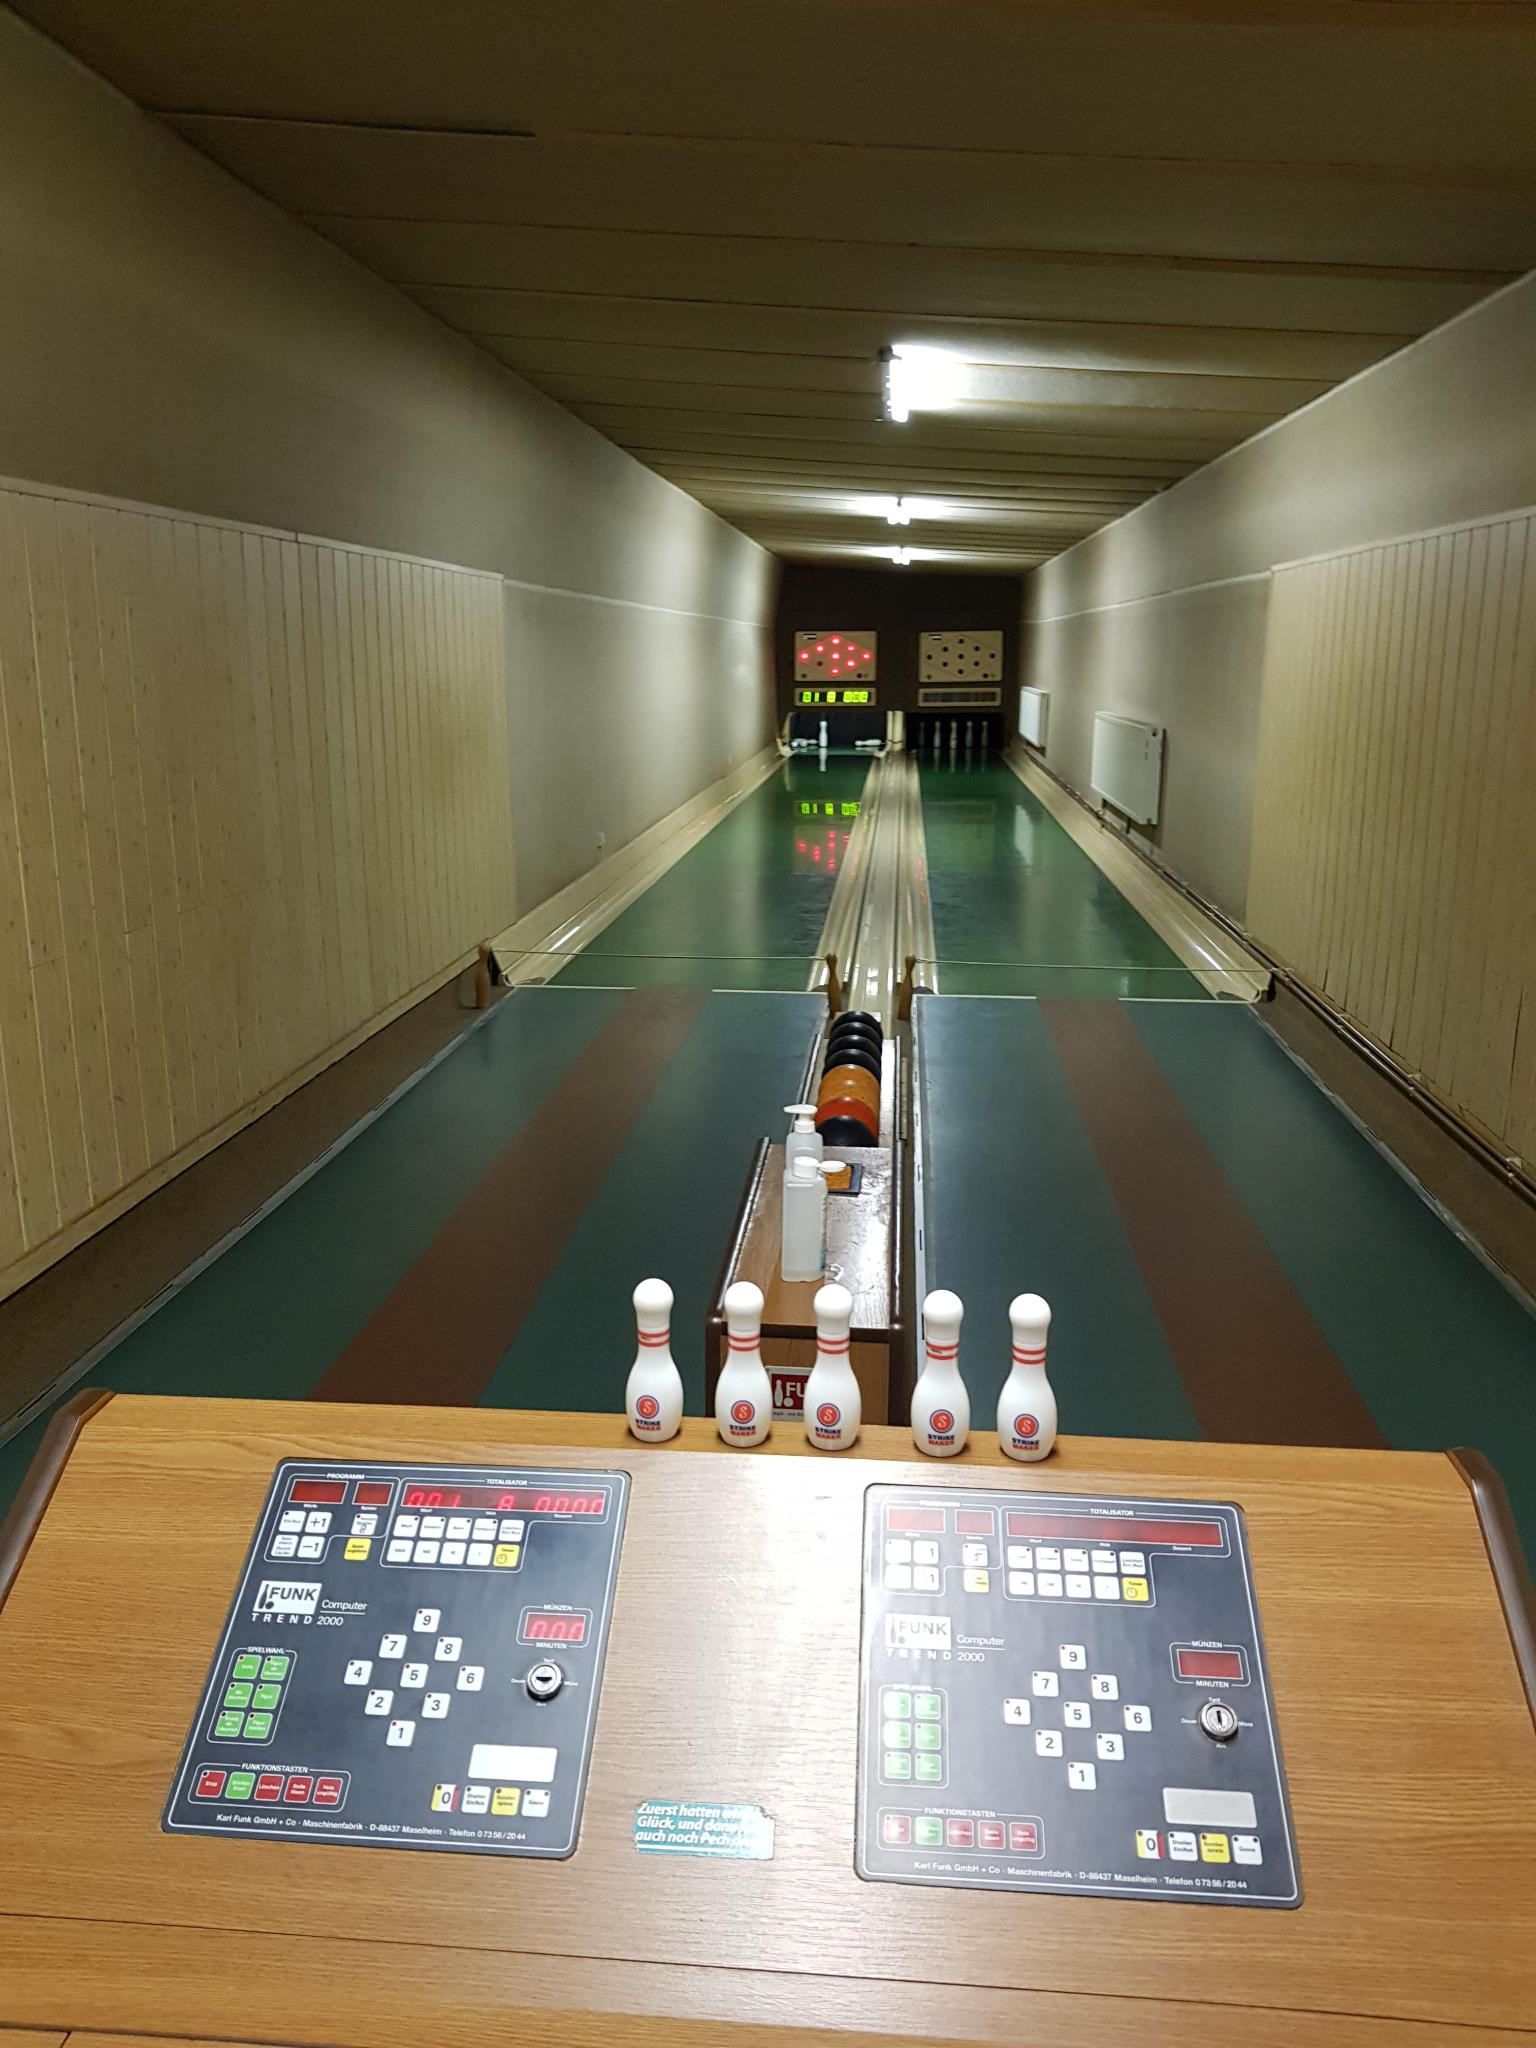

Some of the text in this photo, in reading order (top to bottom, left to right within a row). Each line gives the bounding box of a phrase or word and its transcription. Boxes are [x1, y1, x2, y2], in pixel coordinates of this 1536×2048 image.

[786, 1382, 805, 1398] FU
[1090, 1508, 1134, 1516] TOTALISATOR
[311, 1518, 326, 1526] +1
[269, 1587, 317, 1601] FUNK
[322, 1600, 367, 1610] Computer
[252, 1613, 312, 1625] TREND
[317, 1616, 343, 1626] 2000
[423, 1615, 431, 1625] 9
[899, 1621, 947, 1635] FUNK
[957, 1634, 1004, 1646] Computer
[1192, 1640, 1223, 1648] MÜNZEN
[246, 1646, 285, 1654] SPIELWAHL
[389, 1641, 398, 1651] 7
[444, 1644, 453, 1654] 8
[886, 1648, 951, 1660] TREND
[957, 1652, 984, 1662] 2000
[1069, 1651, 1077, 1662] 9
[354, 1667, 362, 1678] 4
[410, 1670, 419, 1680] 5
[466, 1673, 475, 1683] 6
[1041, 1678, 1049, 1689] 7
[1101, 1682, 1109, 1692] 8
[1195, 1680, 1229, 1688] MINUTEN
[374, 1697, 384, 1708] 2
[432, 1700, 440, 1711] 3
[1014, 1706, 1022, 1716] 4
[1073, 1709, 1082, 1720] 5
[1134, 1712, 1142, 1724] 6
[1045, 1738, 1054, 1749] 2
[1106, 1741, 1115, 1752] 3
[242, 1763, 309, 1773] FUNKTIONSTASTEN
[442, 1792, 451, 1804] 0
[637, 1802, 678, 1815] Zuerst
[679, 1805, 720, 1818] hatten
[924, 1807, 995, 1818] FUNKTIONSTASTEN
[216, 1814, 232, 1822] Karl
[233, 1815, 251, 1823] Funk
[254, 1816, 276, 1824] GmbH
[286, 1818, 296, 1826] Co
[303, 1820, 362, 1830] Maschinenfabrik
[402, 1826, 442, 1835] Maselheim
[450, 1829, 475, 1837] Telefon
[637, 1816, 675, 1830] Glück,
[678, 1819, 703, 1830] und
[636, 1830, 665, 1842] auch
[667, 1832, 698, 1843] noch
[700, 1834, 730, 1845] Pech
[1146, 1838, 1156, 1850] 0
[914, 1862, 930, 1870] Karl
[933, 1863, 952, 1871] Funk
[954, 1864, 978, 1872] GmbH
[989, 1866, 1000, 1874] Co
[1007, 1867, 1072, 1878] Maschinenfabrik
[1114, 1874, 1157, 1884] Maselheim
[1164, 1877, 1193, 1886] Telefon
